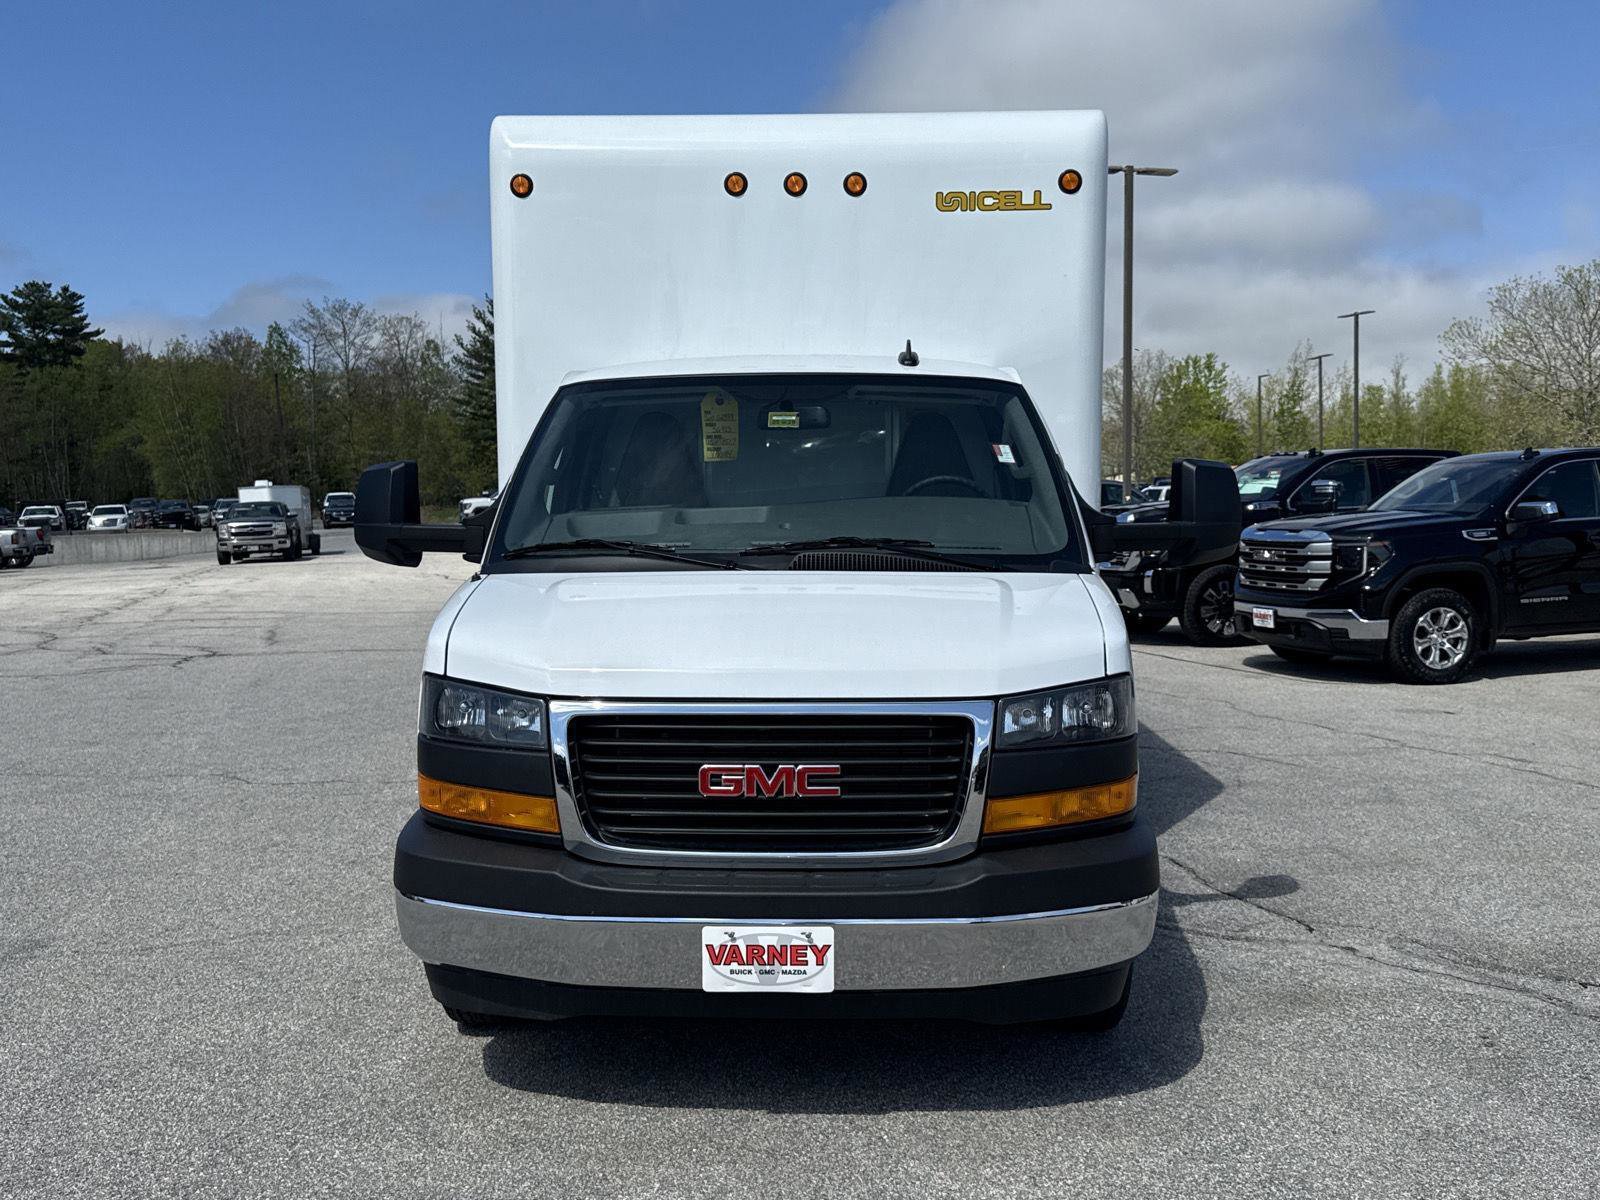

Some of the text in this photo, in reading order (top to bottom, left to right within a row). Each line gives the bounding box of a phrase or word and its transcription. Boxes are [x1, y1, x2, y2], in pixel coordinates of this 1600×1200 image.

[935, 190, 1052, 212] UNICELL
[698, 764, 841, 797] GMC
[705, 944, 832, 967] VARNEY
